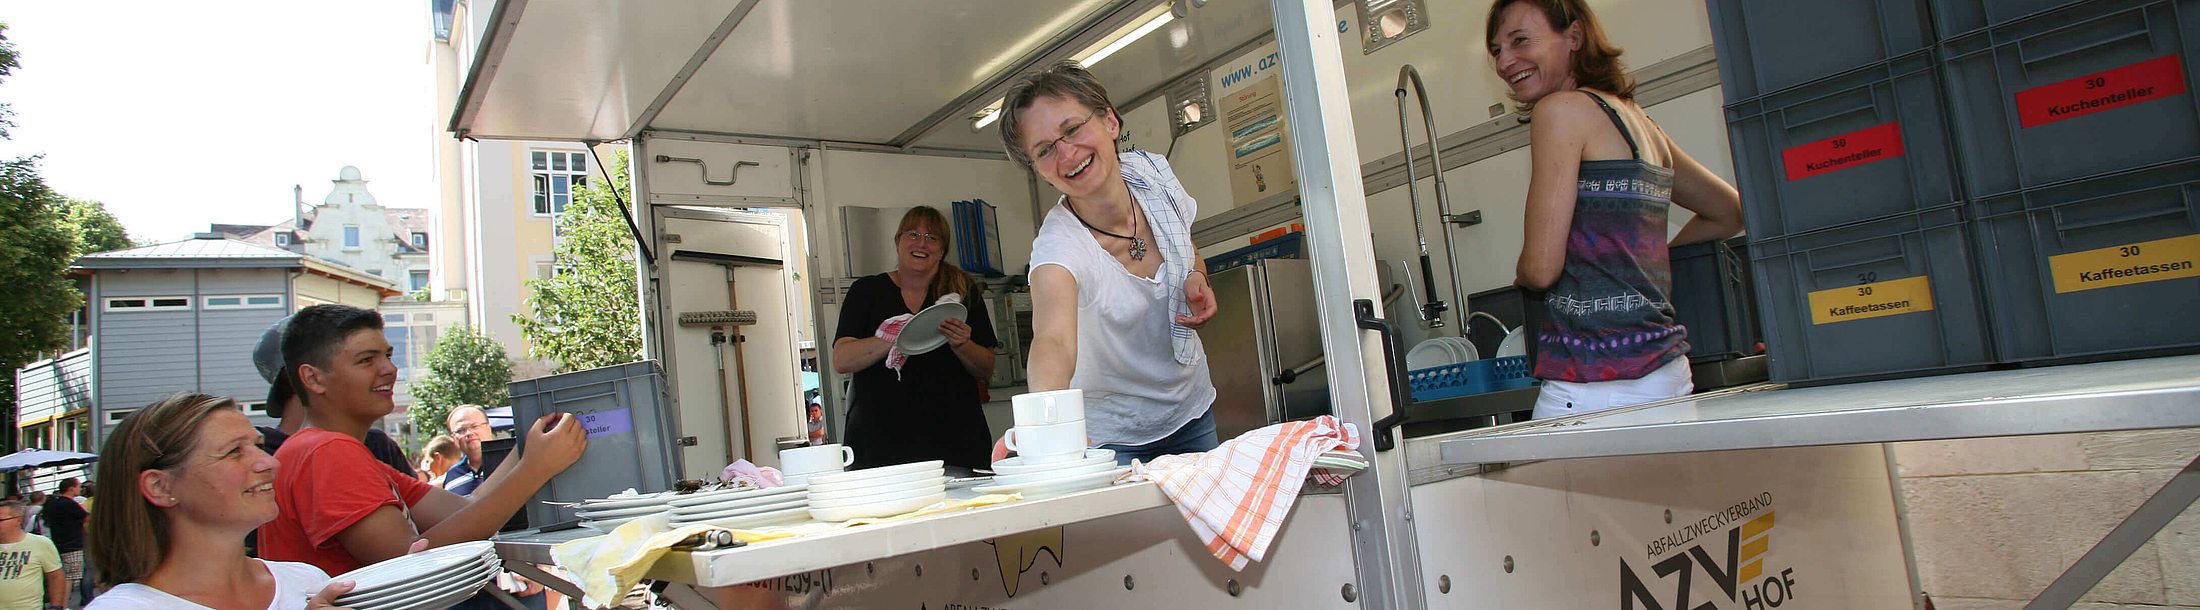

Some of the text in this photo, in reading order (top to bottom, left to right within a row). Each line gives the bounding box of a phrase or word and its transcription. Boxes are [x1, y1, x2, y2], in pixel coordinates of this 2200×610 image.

[2085, 77, 2106, 90] 30
[2048, 86, 2154, 117] Kuchenteller
[1831, 138, 1847, 149] 30
[1806, 148, 1883, 172] Kuchenteller
[2119, 245, 2141, 258] 30
[2079, 260, 2193, 283] Kaffeetassen
[1857, 286, 1873, 297] 30
[1829, 299, 1911, 317] Kaffeetassen
[585, 415, 596, 423] 30
[1647, 491, 1773, 560] ABFALLZWECKVERBAND
[1742, 567, 1796, 610] HOF
